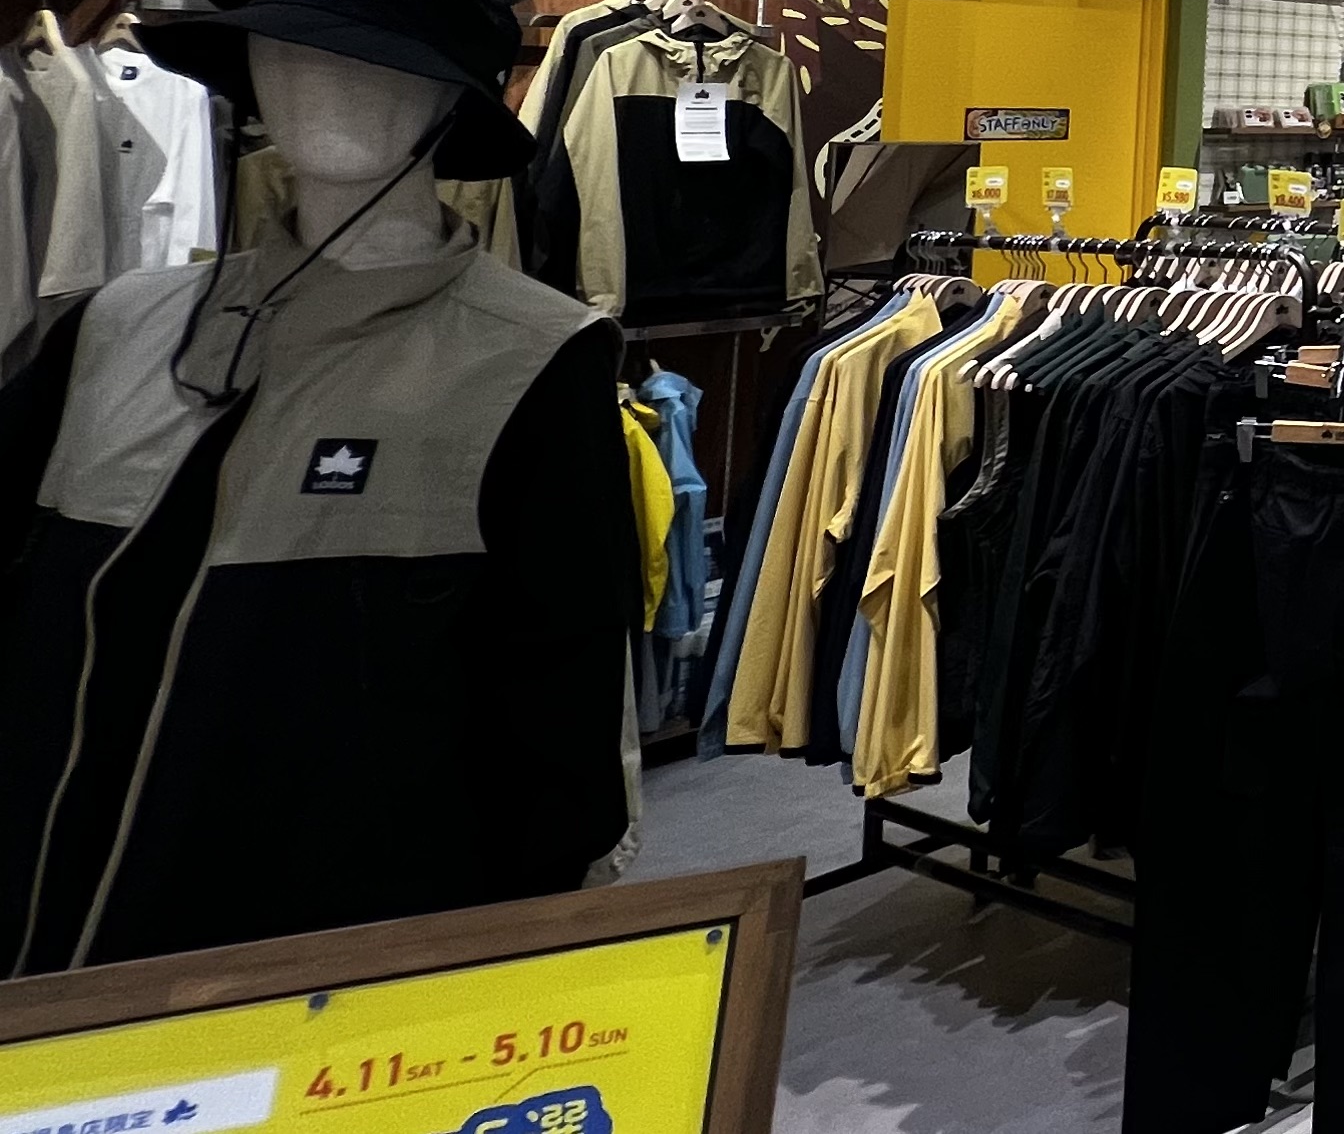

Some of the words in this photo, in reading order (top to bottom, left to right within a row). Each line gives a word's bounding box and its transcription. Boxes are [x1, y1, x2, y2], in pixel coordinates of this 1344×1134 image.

[976, 116, 1022, 133] STAFF
[1022, 117, 1058, 132] ONLY
[304, 1052, 404, 1101] 4.11
[406, 1060, 446, 1082] SAT
[491, 1021, 587, 1066] 5.10
[588, 1027, 629, 1048] SUN
